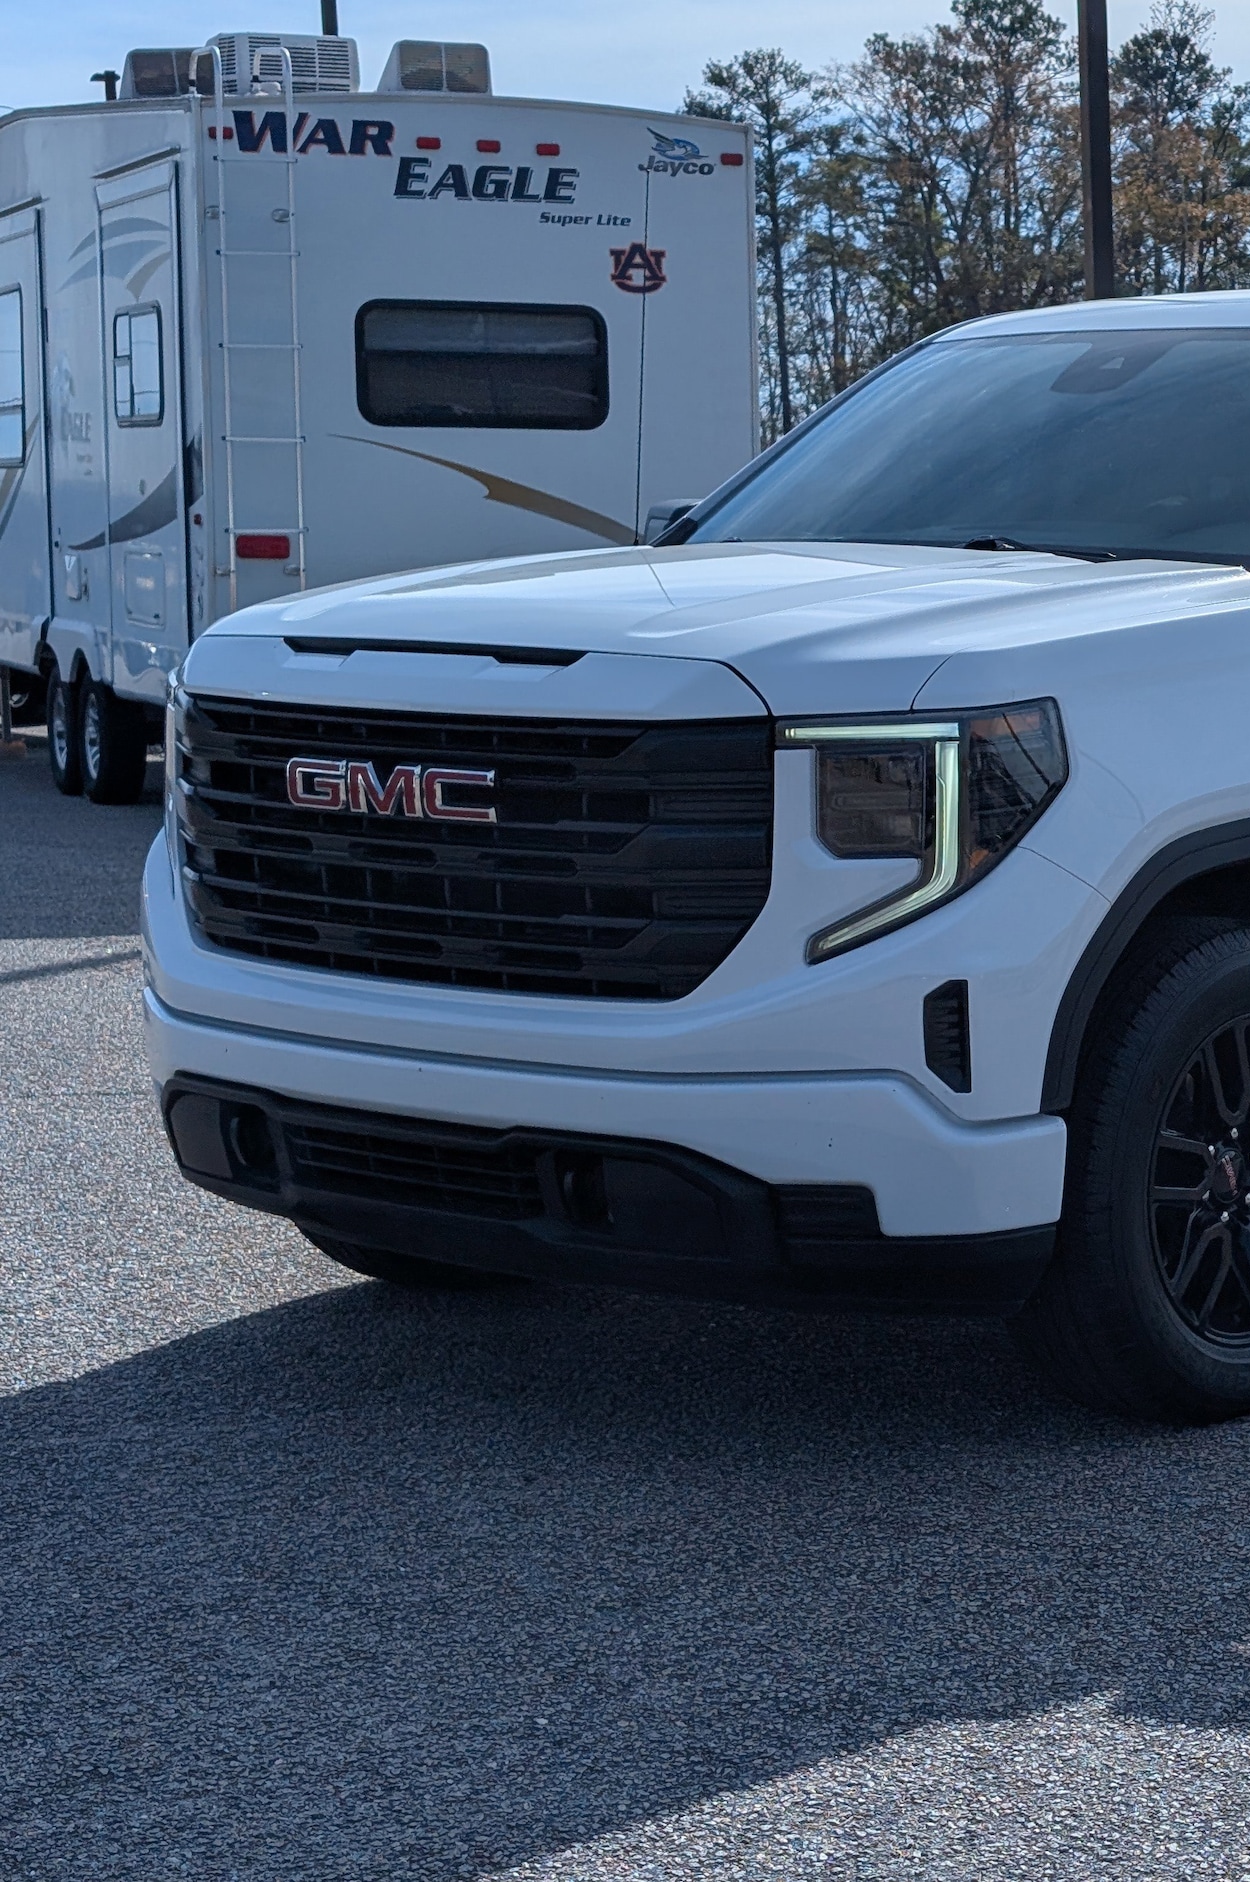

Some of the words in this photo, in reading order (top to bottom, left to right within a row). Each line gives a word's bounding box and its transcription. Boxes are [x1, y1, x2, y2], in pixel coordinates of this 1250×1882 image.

[232, 111, 395, 156] WAR
[394, 156, 580, 204] EAGLE
[637, 154, 716, 177] Jayco
[539, 211, 593, 227] Super
[596, 213, 632, 227] Lite
[286, 757, 497, 823] GMC
